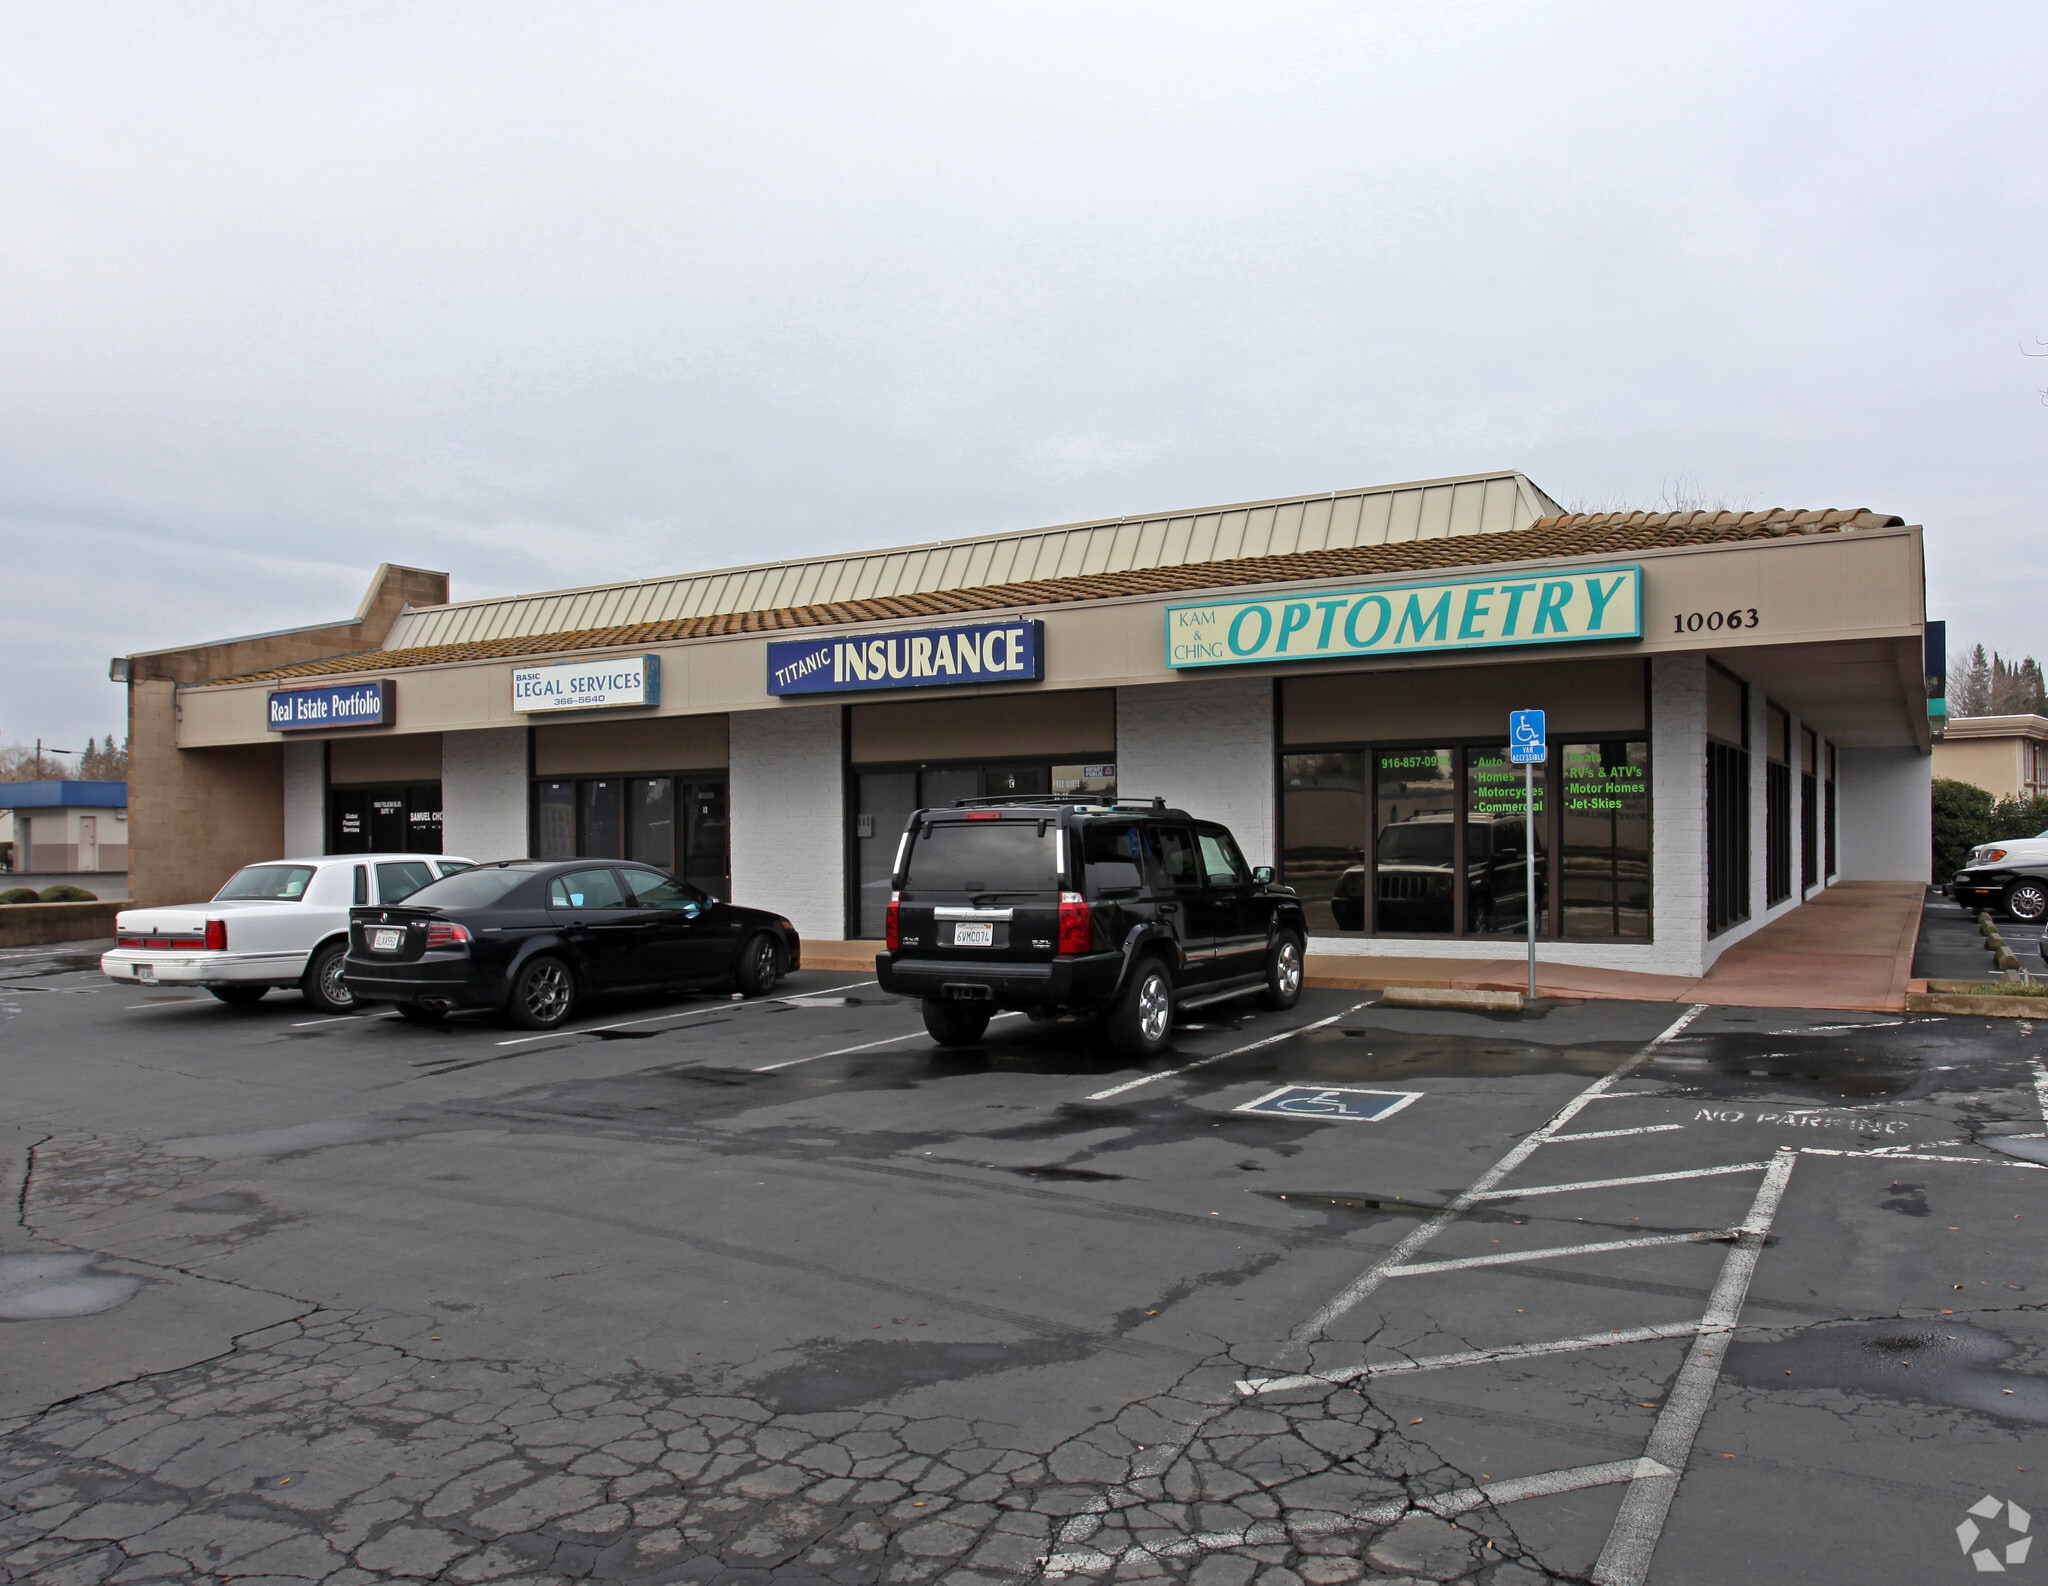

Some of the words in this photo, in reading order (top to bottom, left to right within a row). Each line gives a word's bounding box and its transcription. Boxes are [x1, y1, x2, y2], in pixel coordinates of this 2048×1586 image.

[1179, 610, 1216, 627] KAM
[1227, 576, 1627, 656] OPTOMETRY
[1673, 608, 1759, 634] 10063
[1193, 630, 1202, 641] &
[834, 629, 1024, 682] INSURANCE
[1174, 642, 1223, 660] CHING
[775, 648, 831, 687] TITANIC
[516, 673, 541, 682] BASIC
[516, 680, 563, 698] LEGAL
[570, 672, 641, 694] SERVICES
[271, 698, 293, 722] Real
[297, 698, 328, 720] Estate
[332, 690, 380, 717] Portfolio
[554, 695, 606, 706] 366-5640
[1478, 757, 1503, 767] Auto
[1512, 753, 1544, 761] ACCESSIBLE
[1570, 752, 1602, 763] Boats
[1478, 772, 1515, 783] Homes
[1570, 767, 1595, 779] RV's
[1598, 766, 1607, 778] &
[1610, 766, 1643, 778] ATV's
[1478, 787, 1544, 799] Motorcyces
[1570, 783, 1602, 795] Motor
[1605, 782, 1645, 794] Homes
[1478, 801, 1543, 812] Commercal
[1570, 798, 1623, 810] Jet-Skies
[410, 812, 431, 822] SAMUEL
[1694, 1108, 1745, 1123] NO
